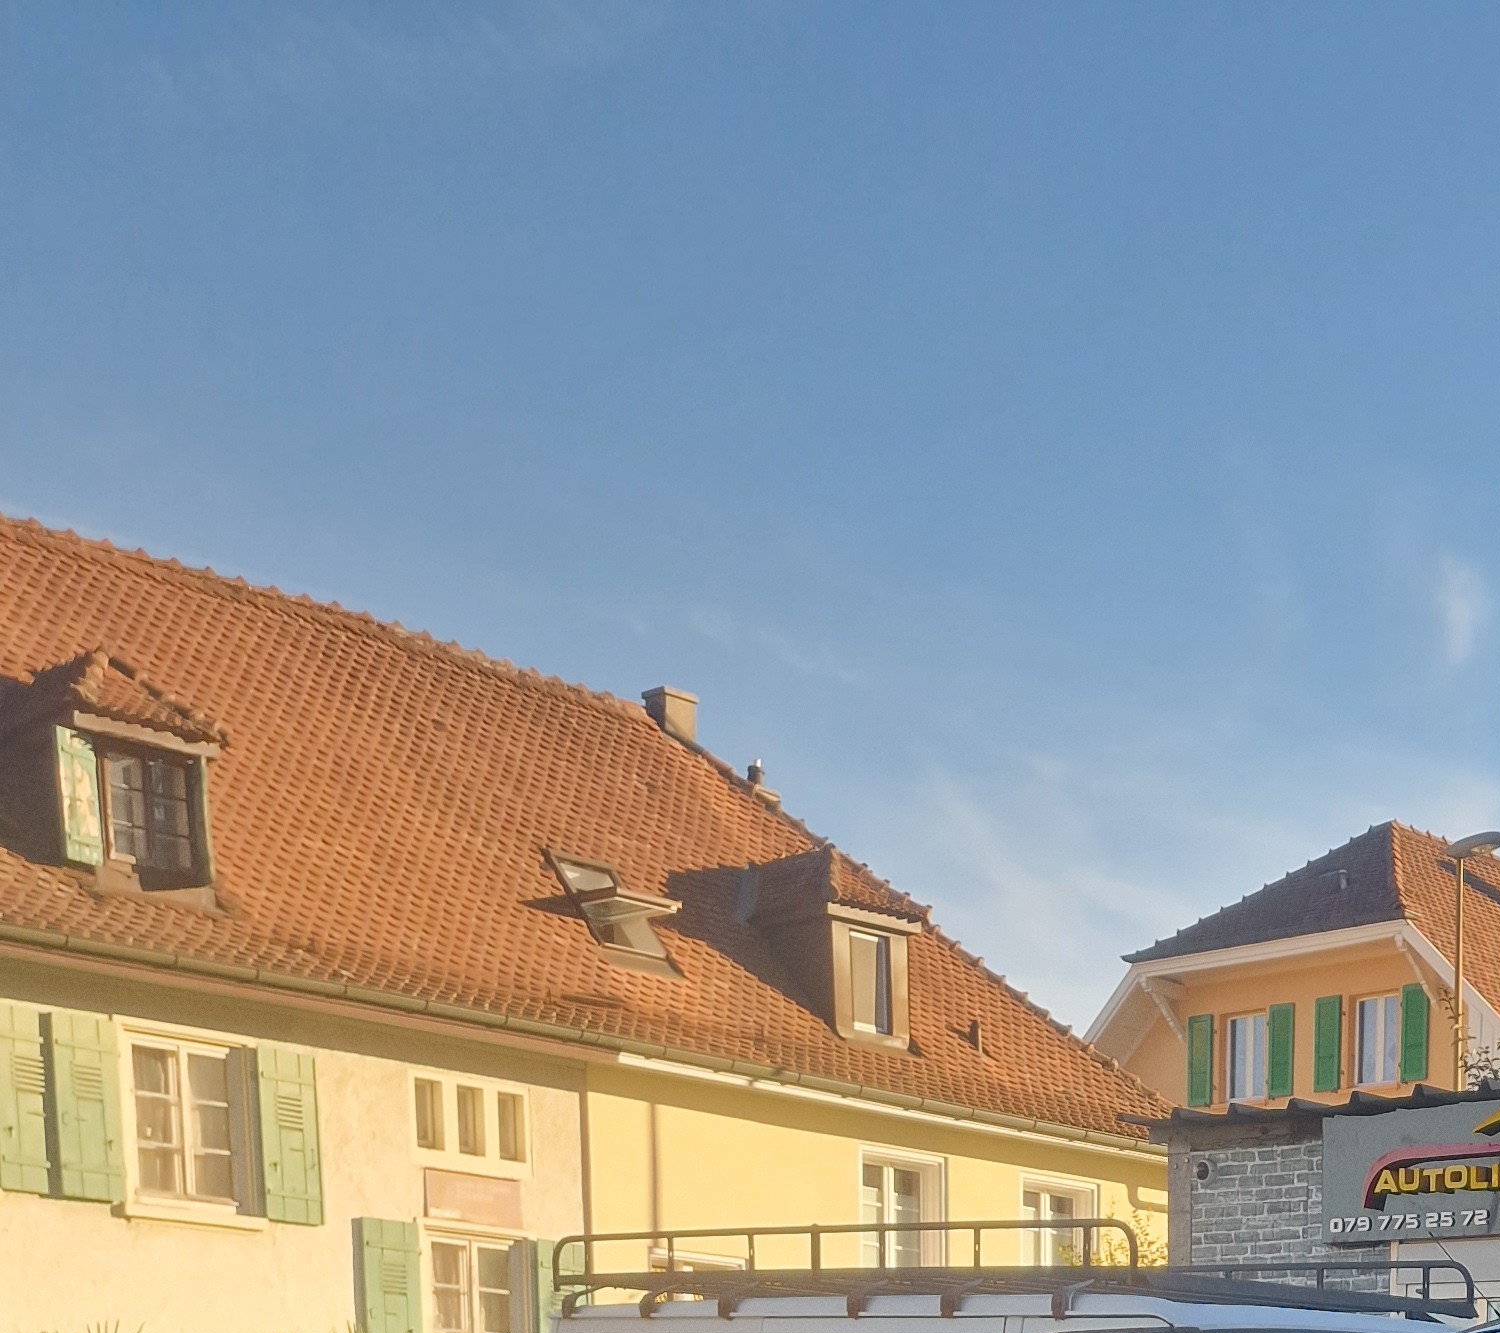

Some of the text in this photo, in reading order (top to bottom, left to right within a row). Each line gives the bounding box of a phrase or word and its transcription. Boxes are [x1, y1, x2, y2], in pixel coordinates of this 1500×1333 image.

[1329, 1209, 1489, 1233] 079 775 25 72
